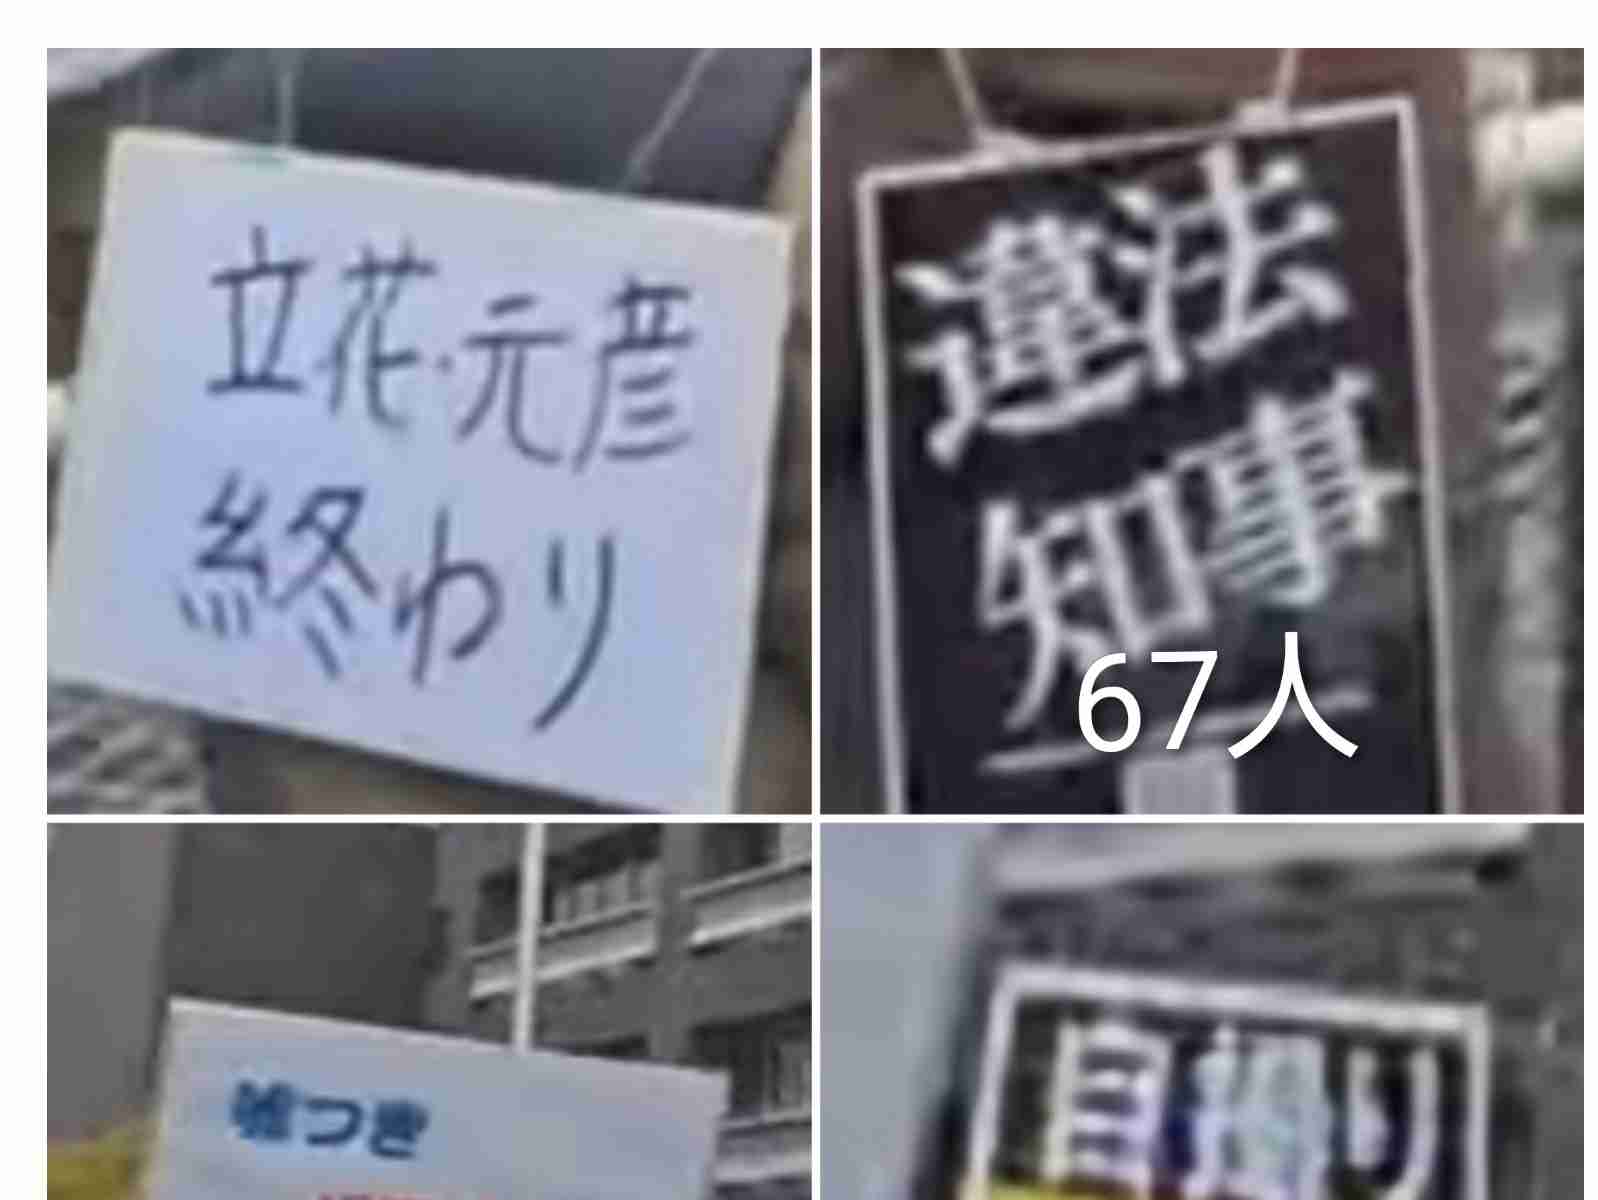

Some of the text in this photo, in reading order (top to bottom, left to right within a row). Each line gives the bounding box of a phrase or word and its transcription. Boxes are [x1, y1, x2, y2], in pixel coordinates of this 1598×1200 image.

[895, 141, 1348, 470] 違法
[178, 470, 615, 732] 終わり
[979, 368, 1410, 735] 知事
